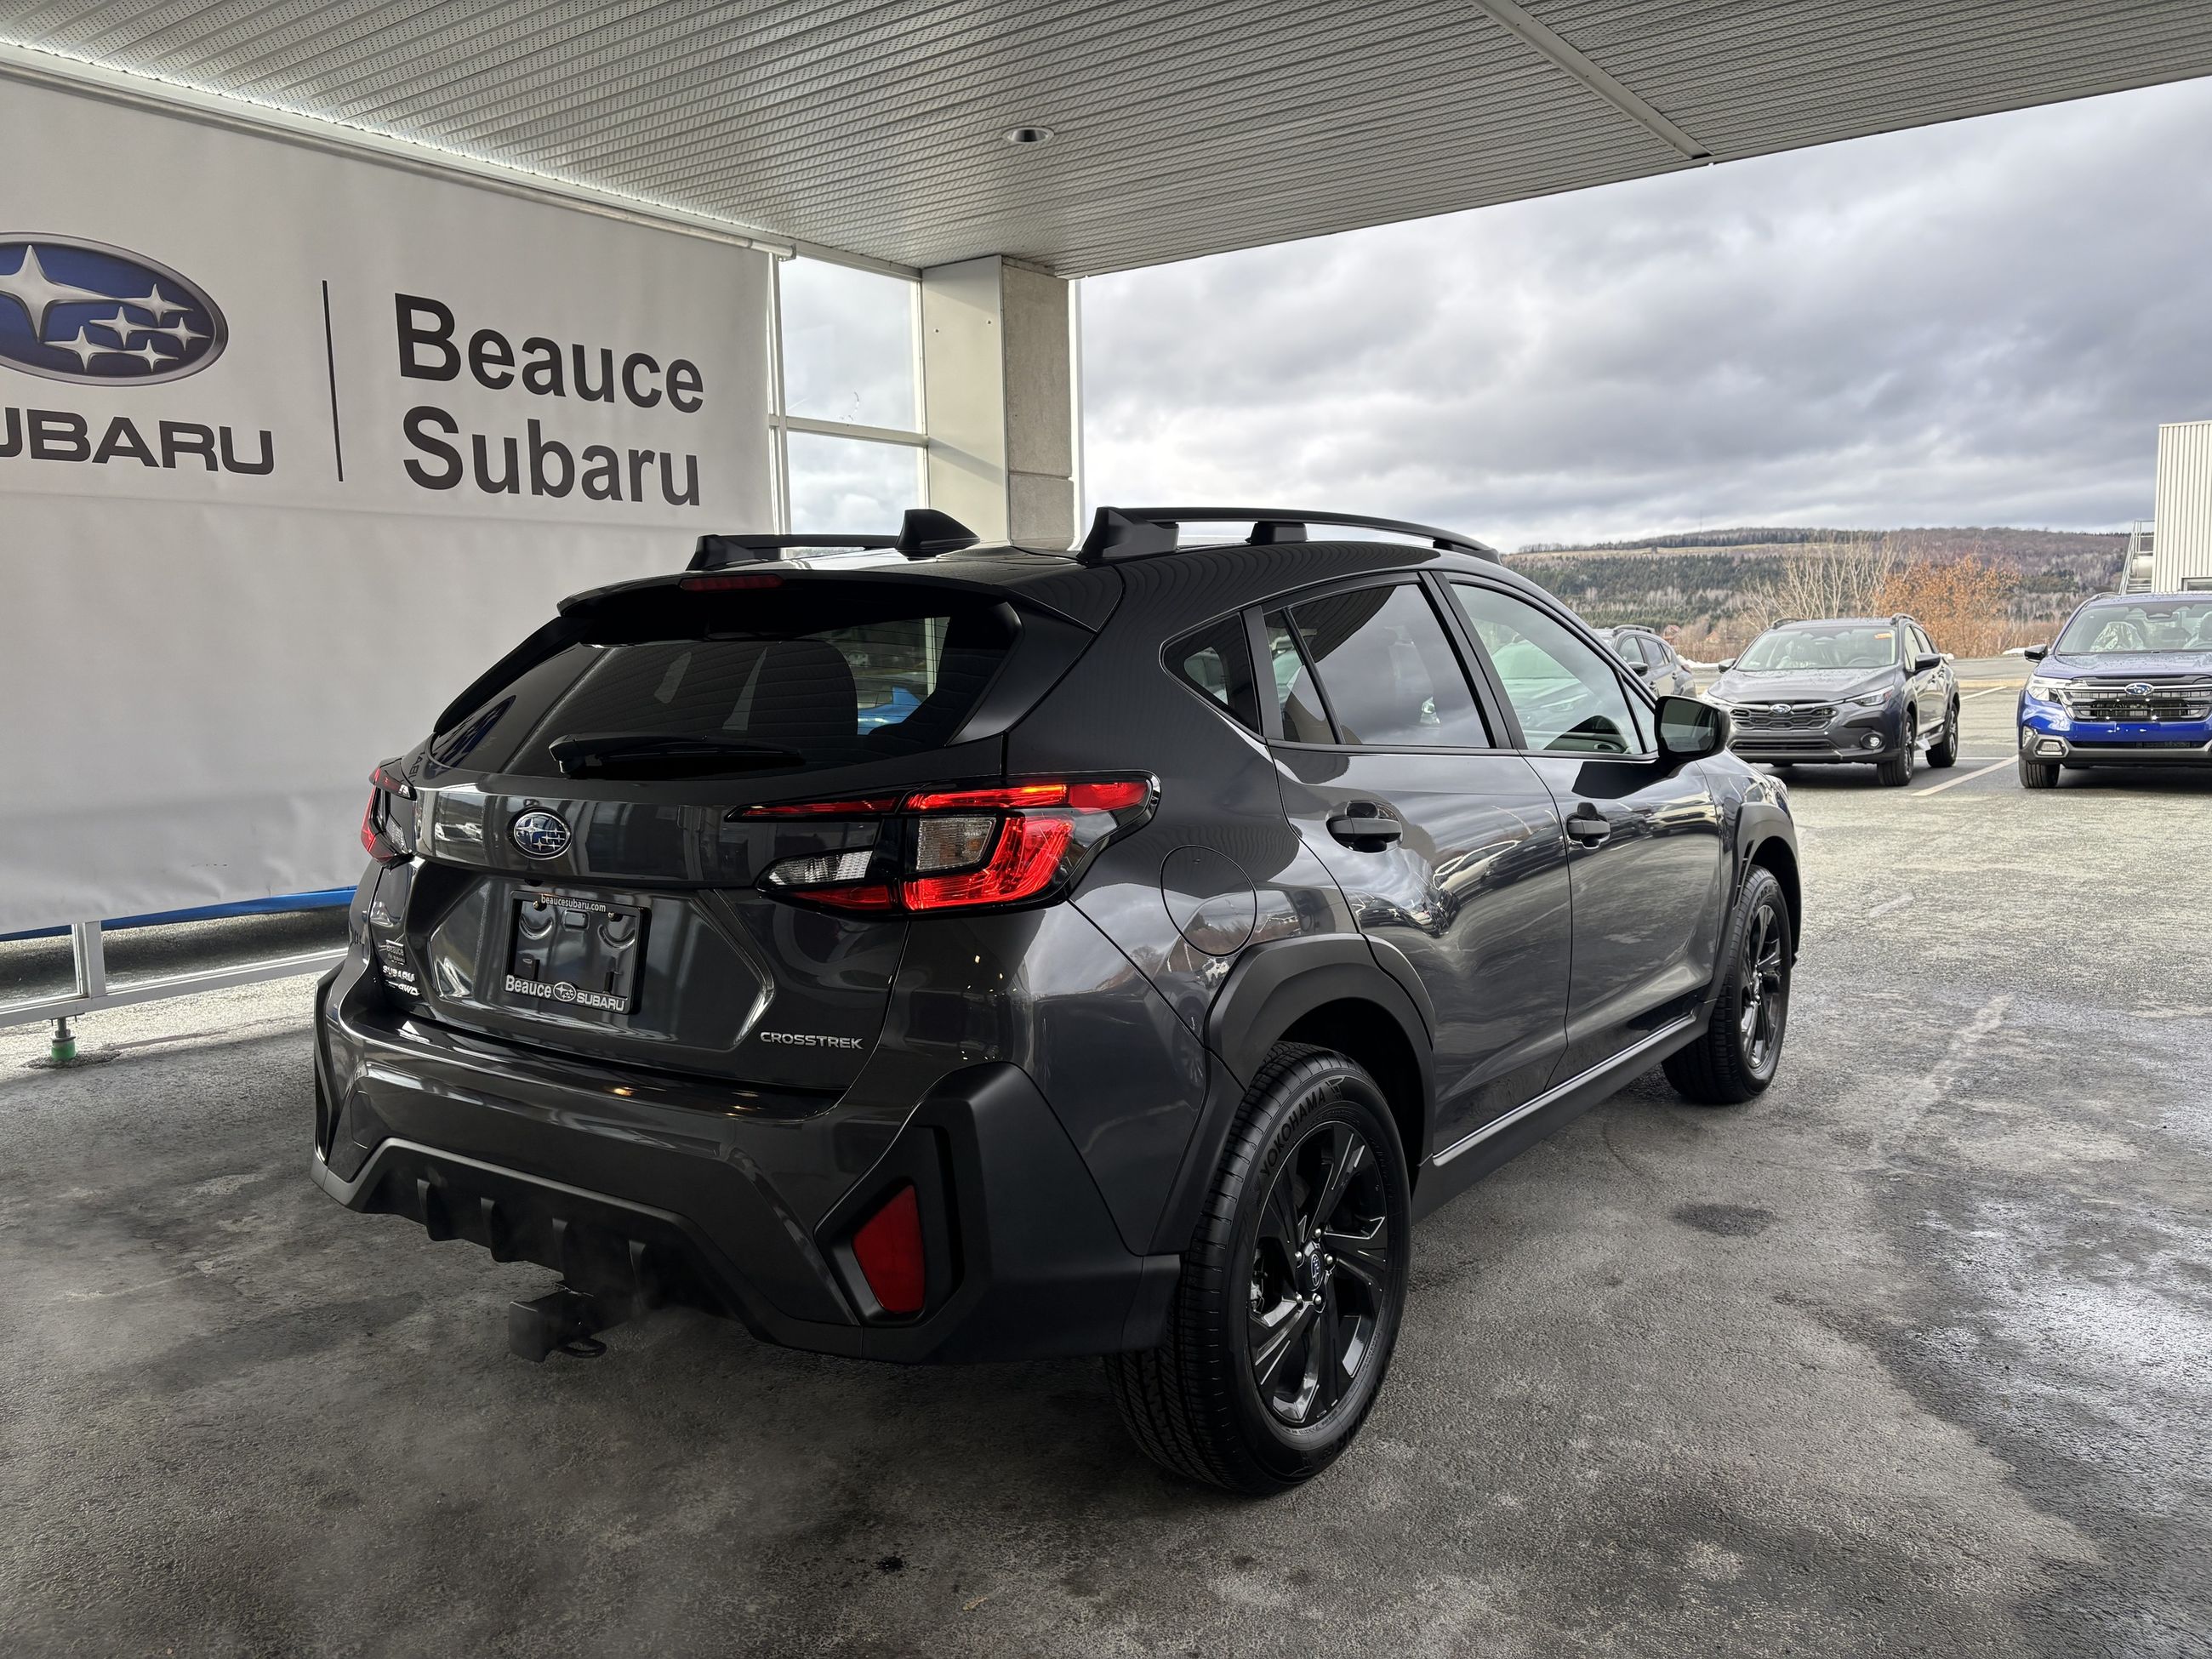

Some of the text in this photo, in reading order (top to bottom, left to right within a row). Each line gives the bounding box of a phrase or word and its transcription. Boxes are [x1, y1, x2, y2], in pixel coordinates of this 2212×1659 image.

[395, 293, 704, 413] Beauce
[403, 405, 700, 506] Subaru
[540, 893, 607, 913] beaucesubaru.com
[382, 965, 415, 983] SUBARU
[505, 974, 625, 1012] Beauce SUBARU
[760, 1031, 864, 1050] CROSSTREK
[1260, 1086, 1326, 1177] YOKOHAMA
